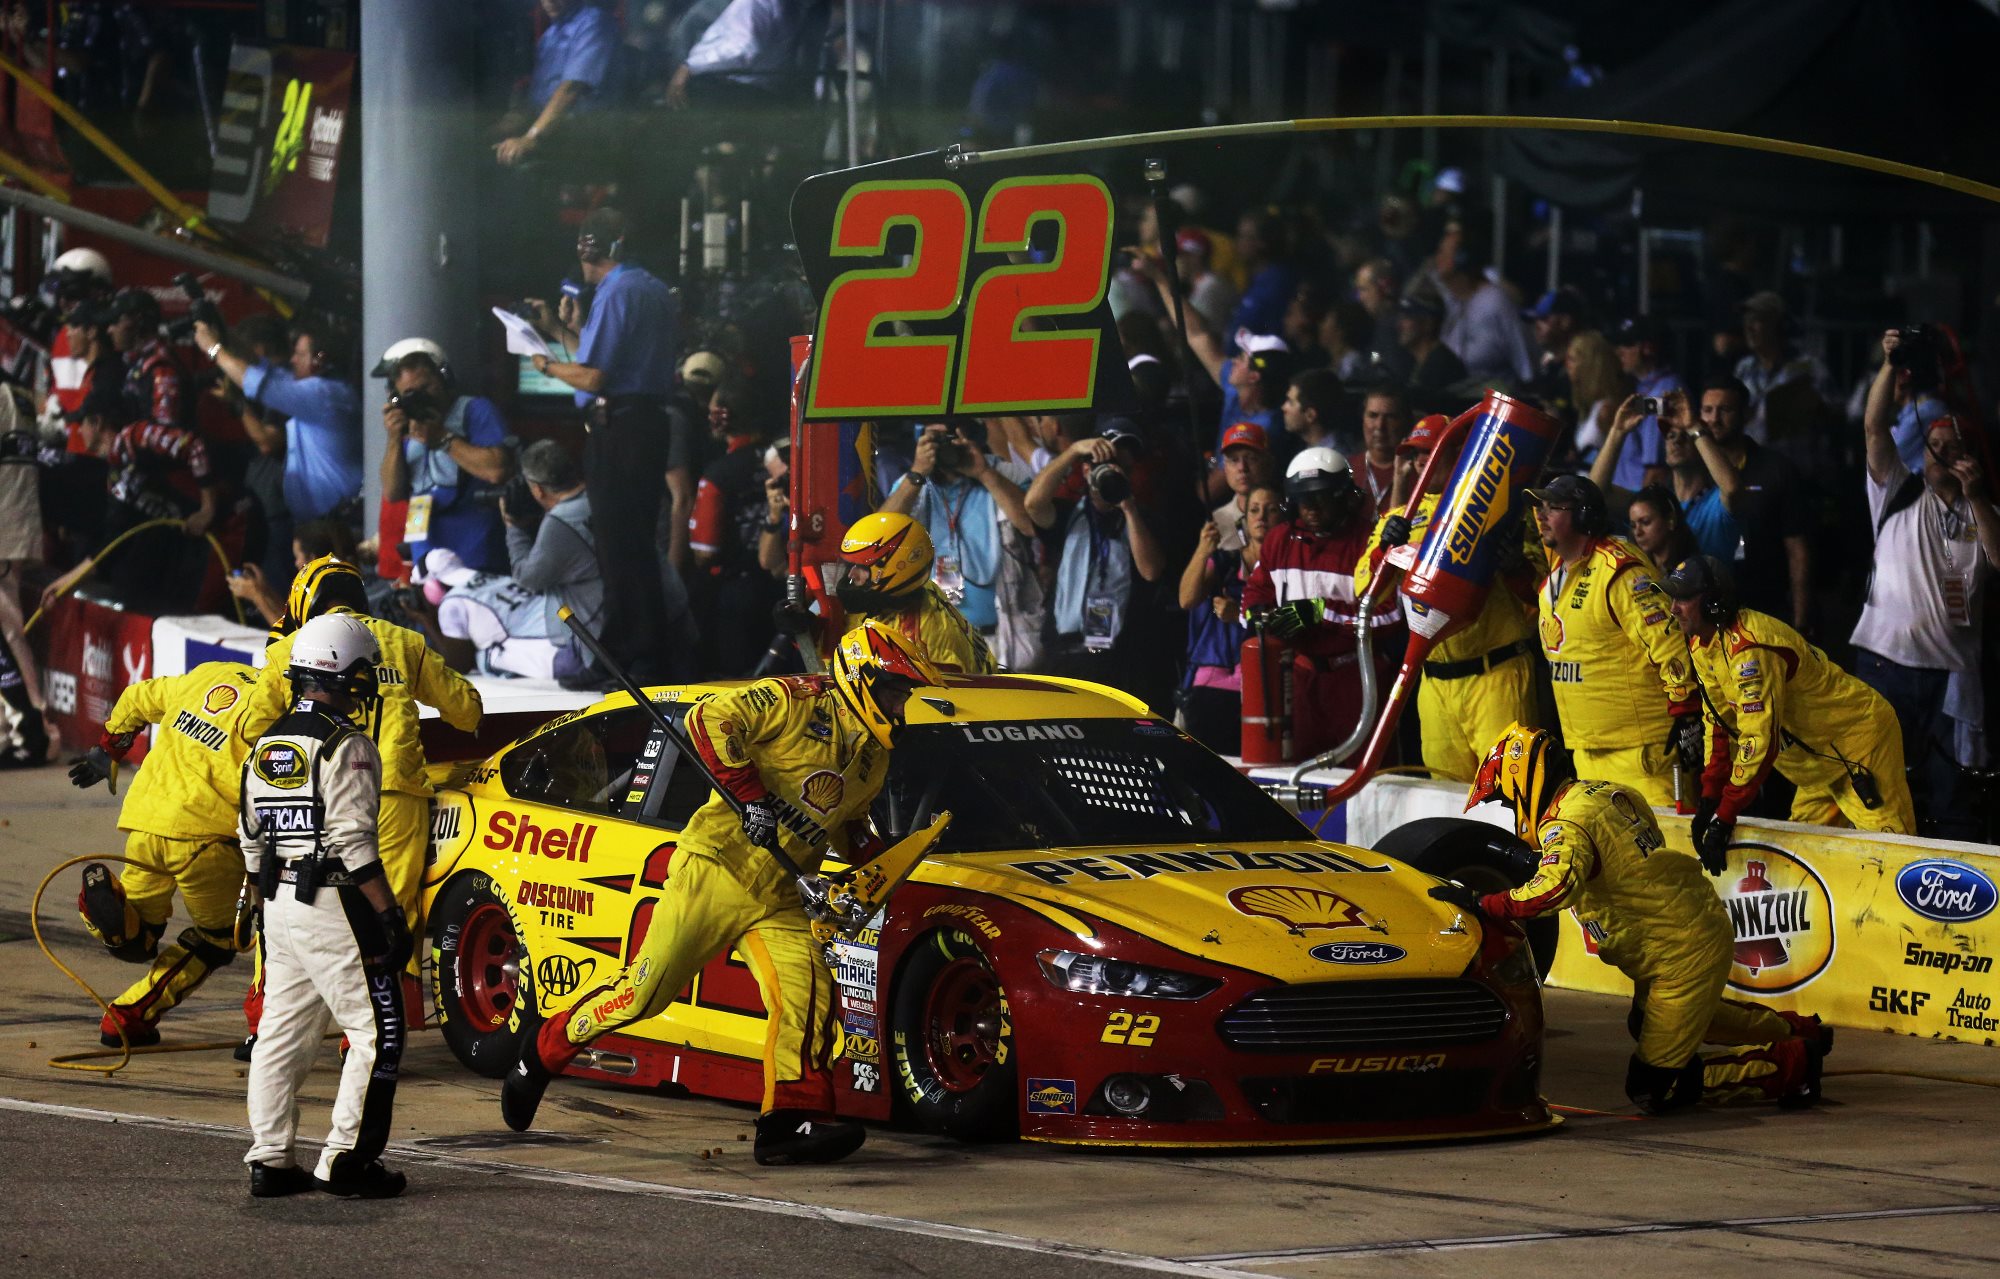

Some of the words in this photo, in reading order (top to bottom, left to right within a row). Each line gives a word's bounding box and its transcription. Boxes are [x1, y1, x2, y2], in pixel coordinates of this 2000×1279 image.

[806, 172, 1115, 419] 22
[1449, 440, 1513, 560] SUNOCO
[173, 710, 228, 751] PENNZOIL
[962, 724, 1085, 743] LOGANO
[270, 751, 294, 760] NASCAR
[272, 763, 293, 775] Sprint
[464, 768, 499, 784] SKF
[483, 811, 598, 863] Shell
[1003, 850, 1394, 885] PENNZOIL
[516, 880, 594, 916] DISCOUNT
[1916, 867, 1977, 912] Ford
[539, 910, 575, 930] TIRE
[922, 904, 1002, 940] GOODYEAR
[1725, 890, 1811, 939] NNZOIL
[847, 954, 876, 969] freescale
[1331, 944, 1388, 960] Ford
[1904, 942, 1993, 975] Snap-on
[837, 963, 877, 987] MAHLE
[593, 986, 635, 1023] Shell
[843, 989, 873, 1001] LINCOLN
[850, 1000, 874, 1012] WELDERS
[1869, 986, 1931, 1016] SKF
[1952, 987, 1991, 1011] Auto
[1100, 1011, 1162, 1047] 22
[1946, 1008, 1999, 1032] Trader
[894, 1029, 926, 1104] EAGLE
[1030, 1091, 1075, 1104] SUNOCO
